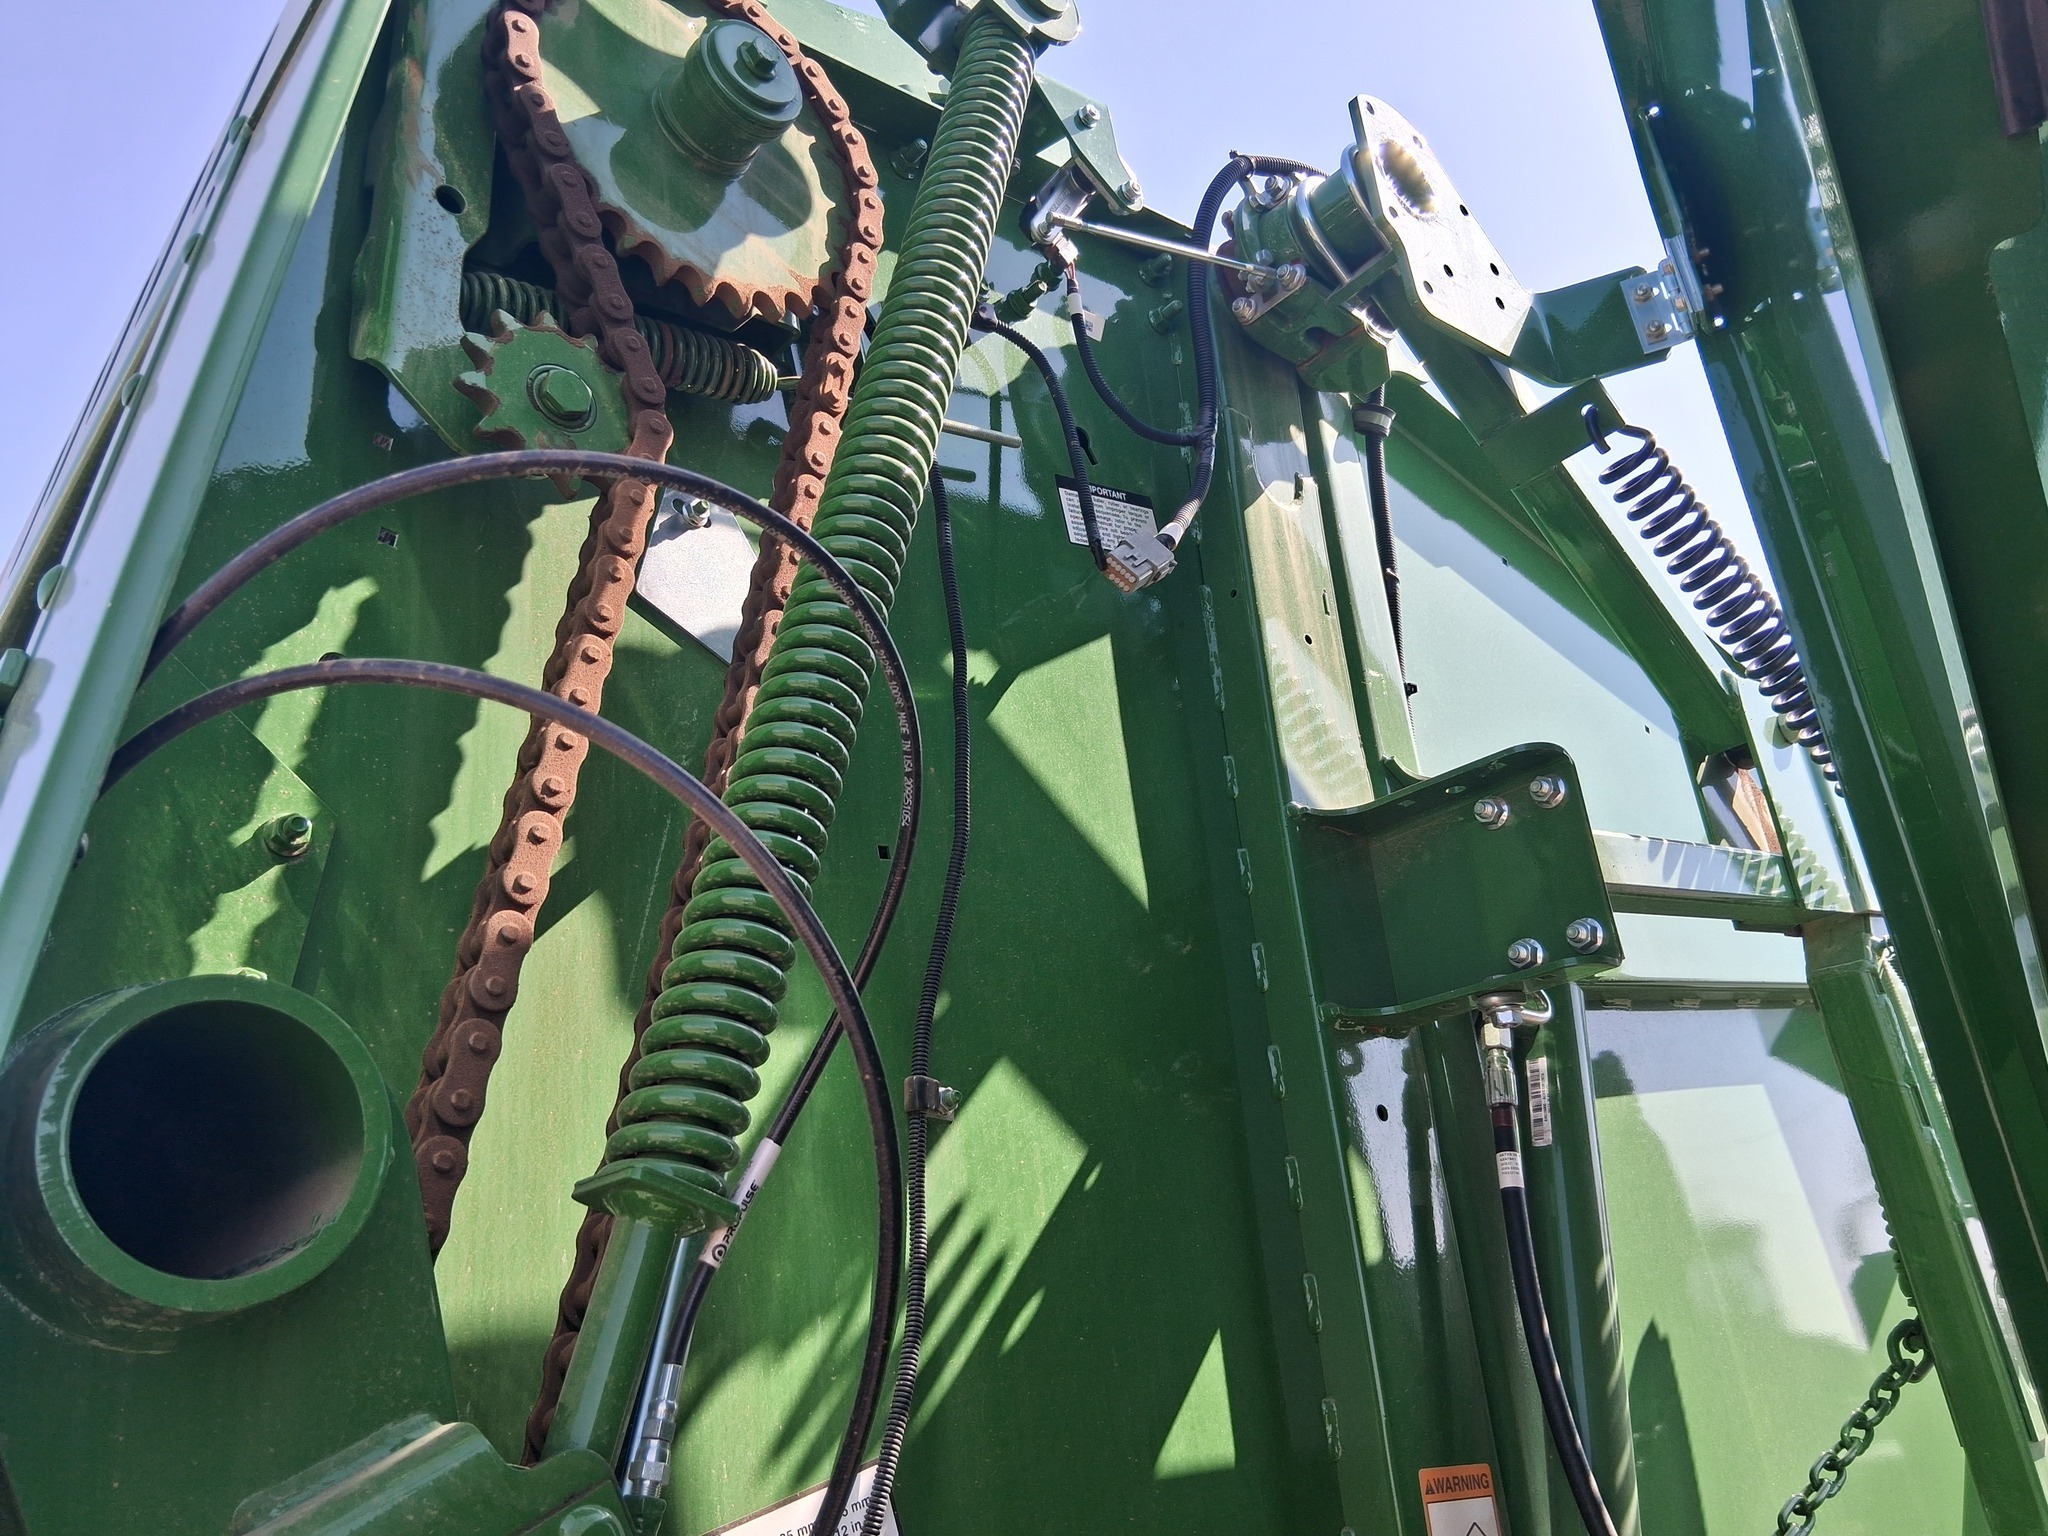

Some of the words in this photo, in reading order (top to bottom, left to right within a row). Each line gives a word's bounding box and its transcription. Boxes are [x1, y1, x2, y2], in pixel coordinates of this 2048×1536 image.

[1089, 485, 1127, 500] PORTANT
[897, 710, 909, 735] MADE
[902, 739, 911, 751] IN
[903, 754, 913, 771] USA
[1433, 1473, 1489, 1493] WARNING
